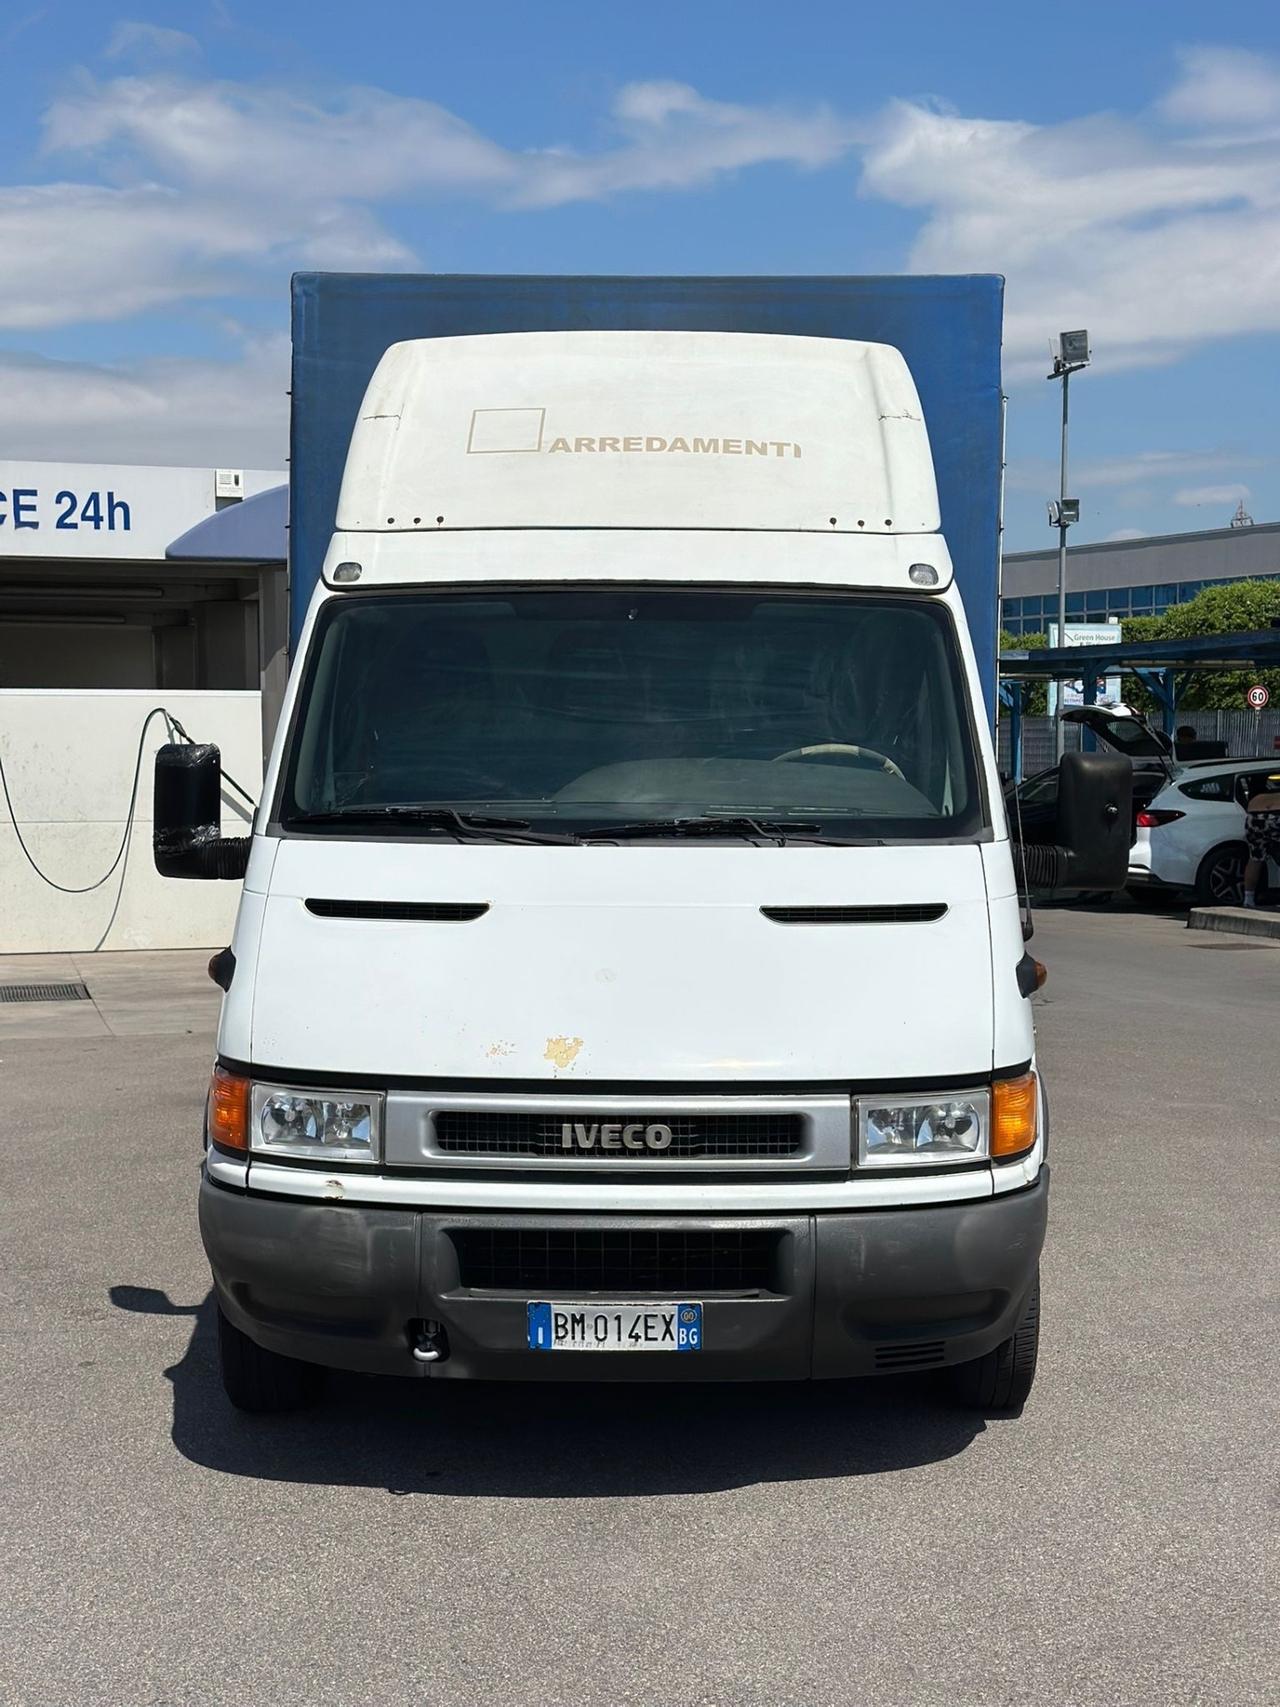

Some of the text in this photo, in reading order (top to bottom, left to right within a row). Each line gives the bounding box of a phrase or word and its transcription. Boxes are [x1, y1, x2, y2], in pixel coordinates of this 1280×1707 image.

[548, 436, 802, 458] ARREDAMENTI
[55, 490, 131, 531] 24h
[1074, 633, 1095, 641] Green
[1252, 692, 1263, 701] 60
[562, 1123, 673, 1149] IVECO
[554, 1312, 586, 1341] BM
[594, 1313, 676, 1343] 014EX
[679, 1328, 698, 1345] BG
